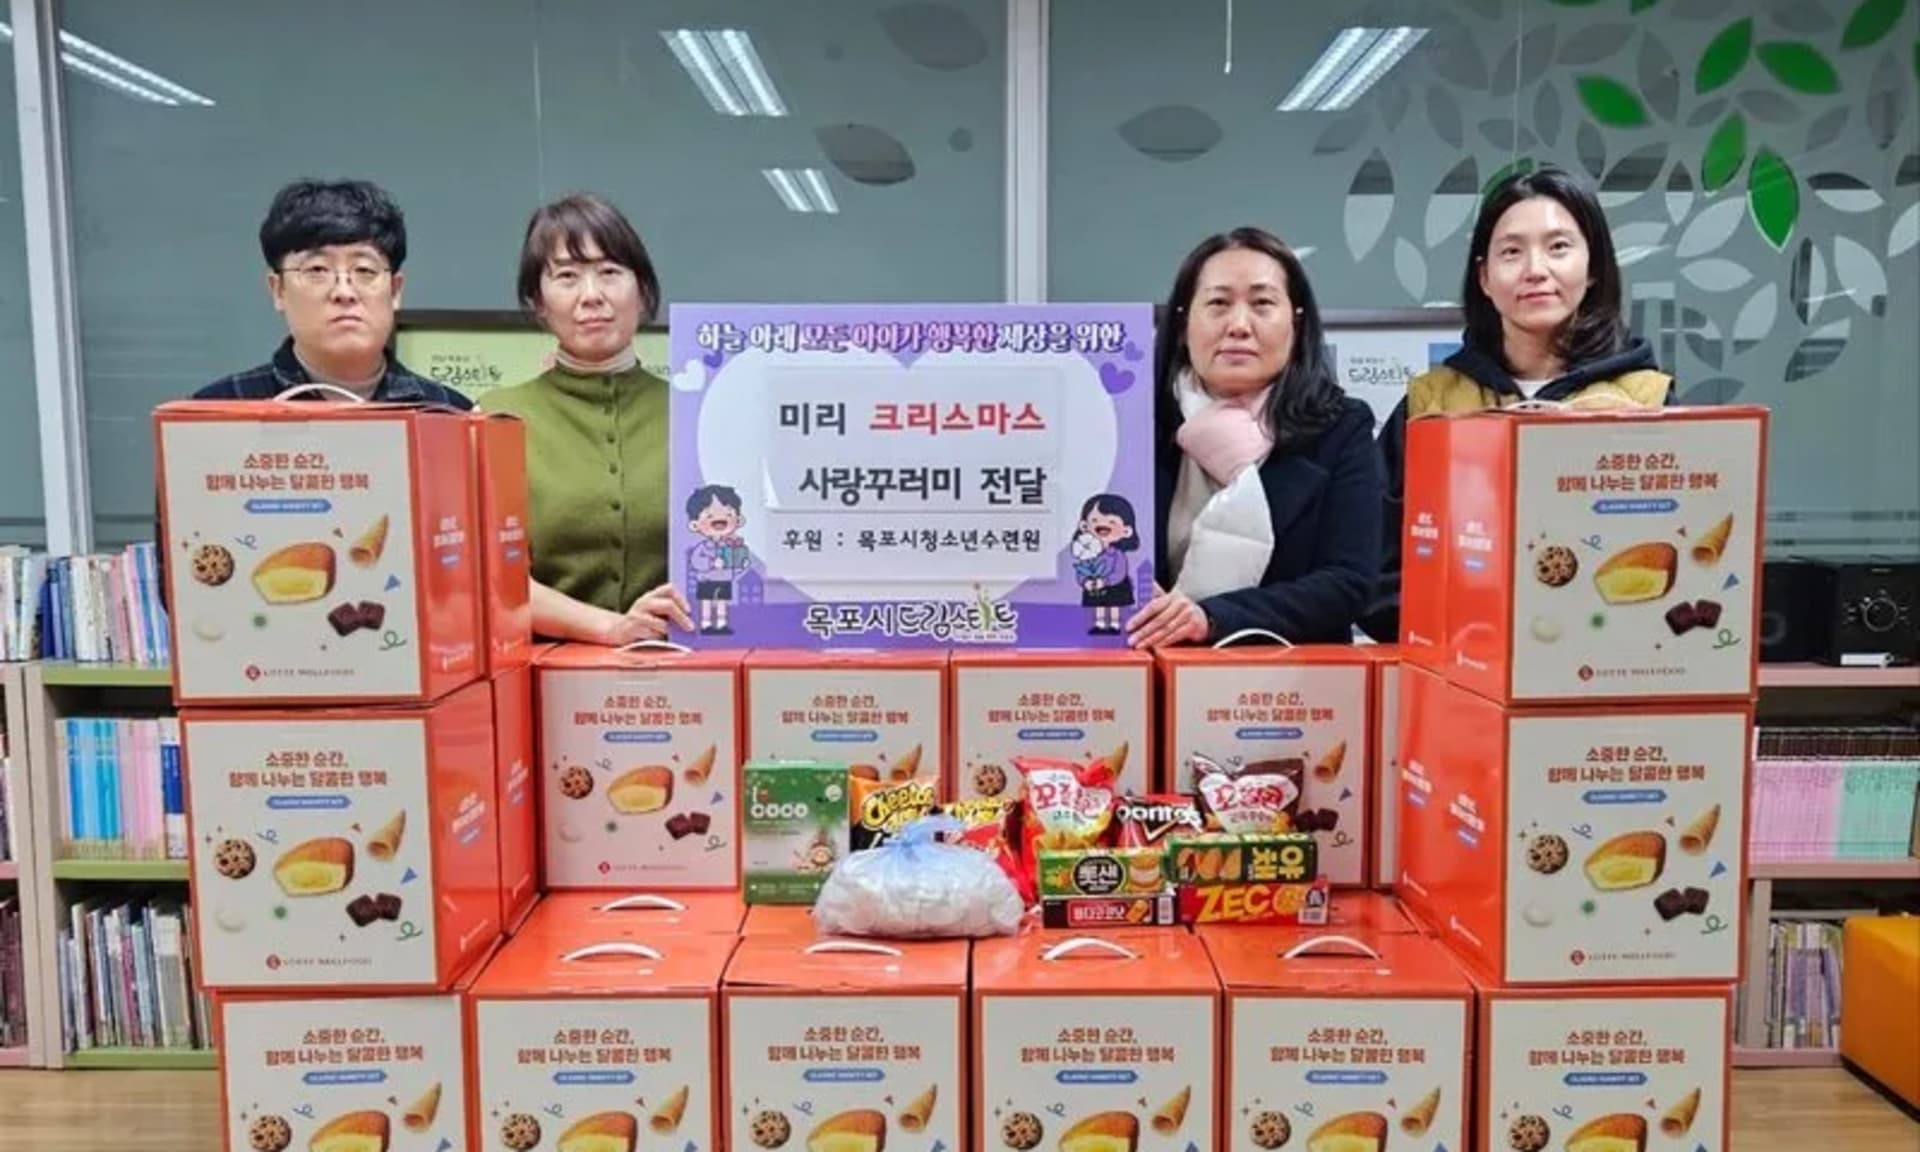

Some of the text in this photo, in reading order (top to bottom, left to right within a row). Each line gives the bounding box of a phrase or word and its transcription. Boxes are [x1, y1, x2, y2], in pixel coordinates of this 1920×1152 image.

[697, 322, 1125, 352] 하늘 아래 모든 아이가 행복한 세상을 위한
[779, 403, 1046, 435] 미리 크리스마스
[239, 475, 286, 490] 나누는
[799, 467, 1047, 505] 사랑꾸러미 전달
[1591, 476, 1635, 490] 나누는
[782, 530, 822, 551] 후원
[857, 529, 1041, 552] 목포시청소년수련원
[805, 606, 893, 637] 목포시
[261, 772, 305, 787] 나누는
[1581, 767, 1624, 782] 나누는
[300, 1049, 342, 1063] 나누는
[550, 1050, 592, 1063] 나누는
[801, 1046, 842, 1061] 나누는
[1053, 1047, 1095, 1062] 나누는
[1303, 1047, 1345, 1062] 나누는
[1562, 1050, 1605, 1065] 나누는
